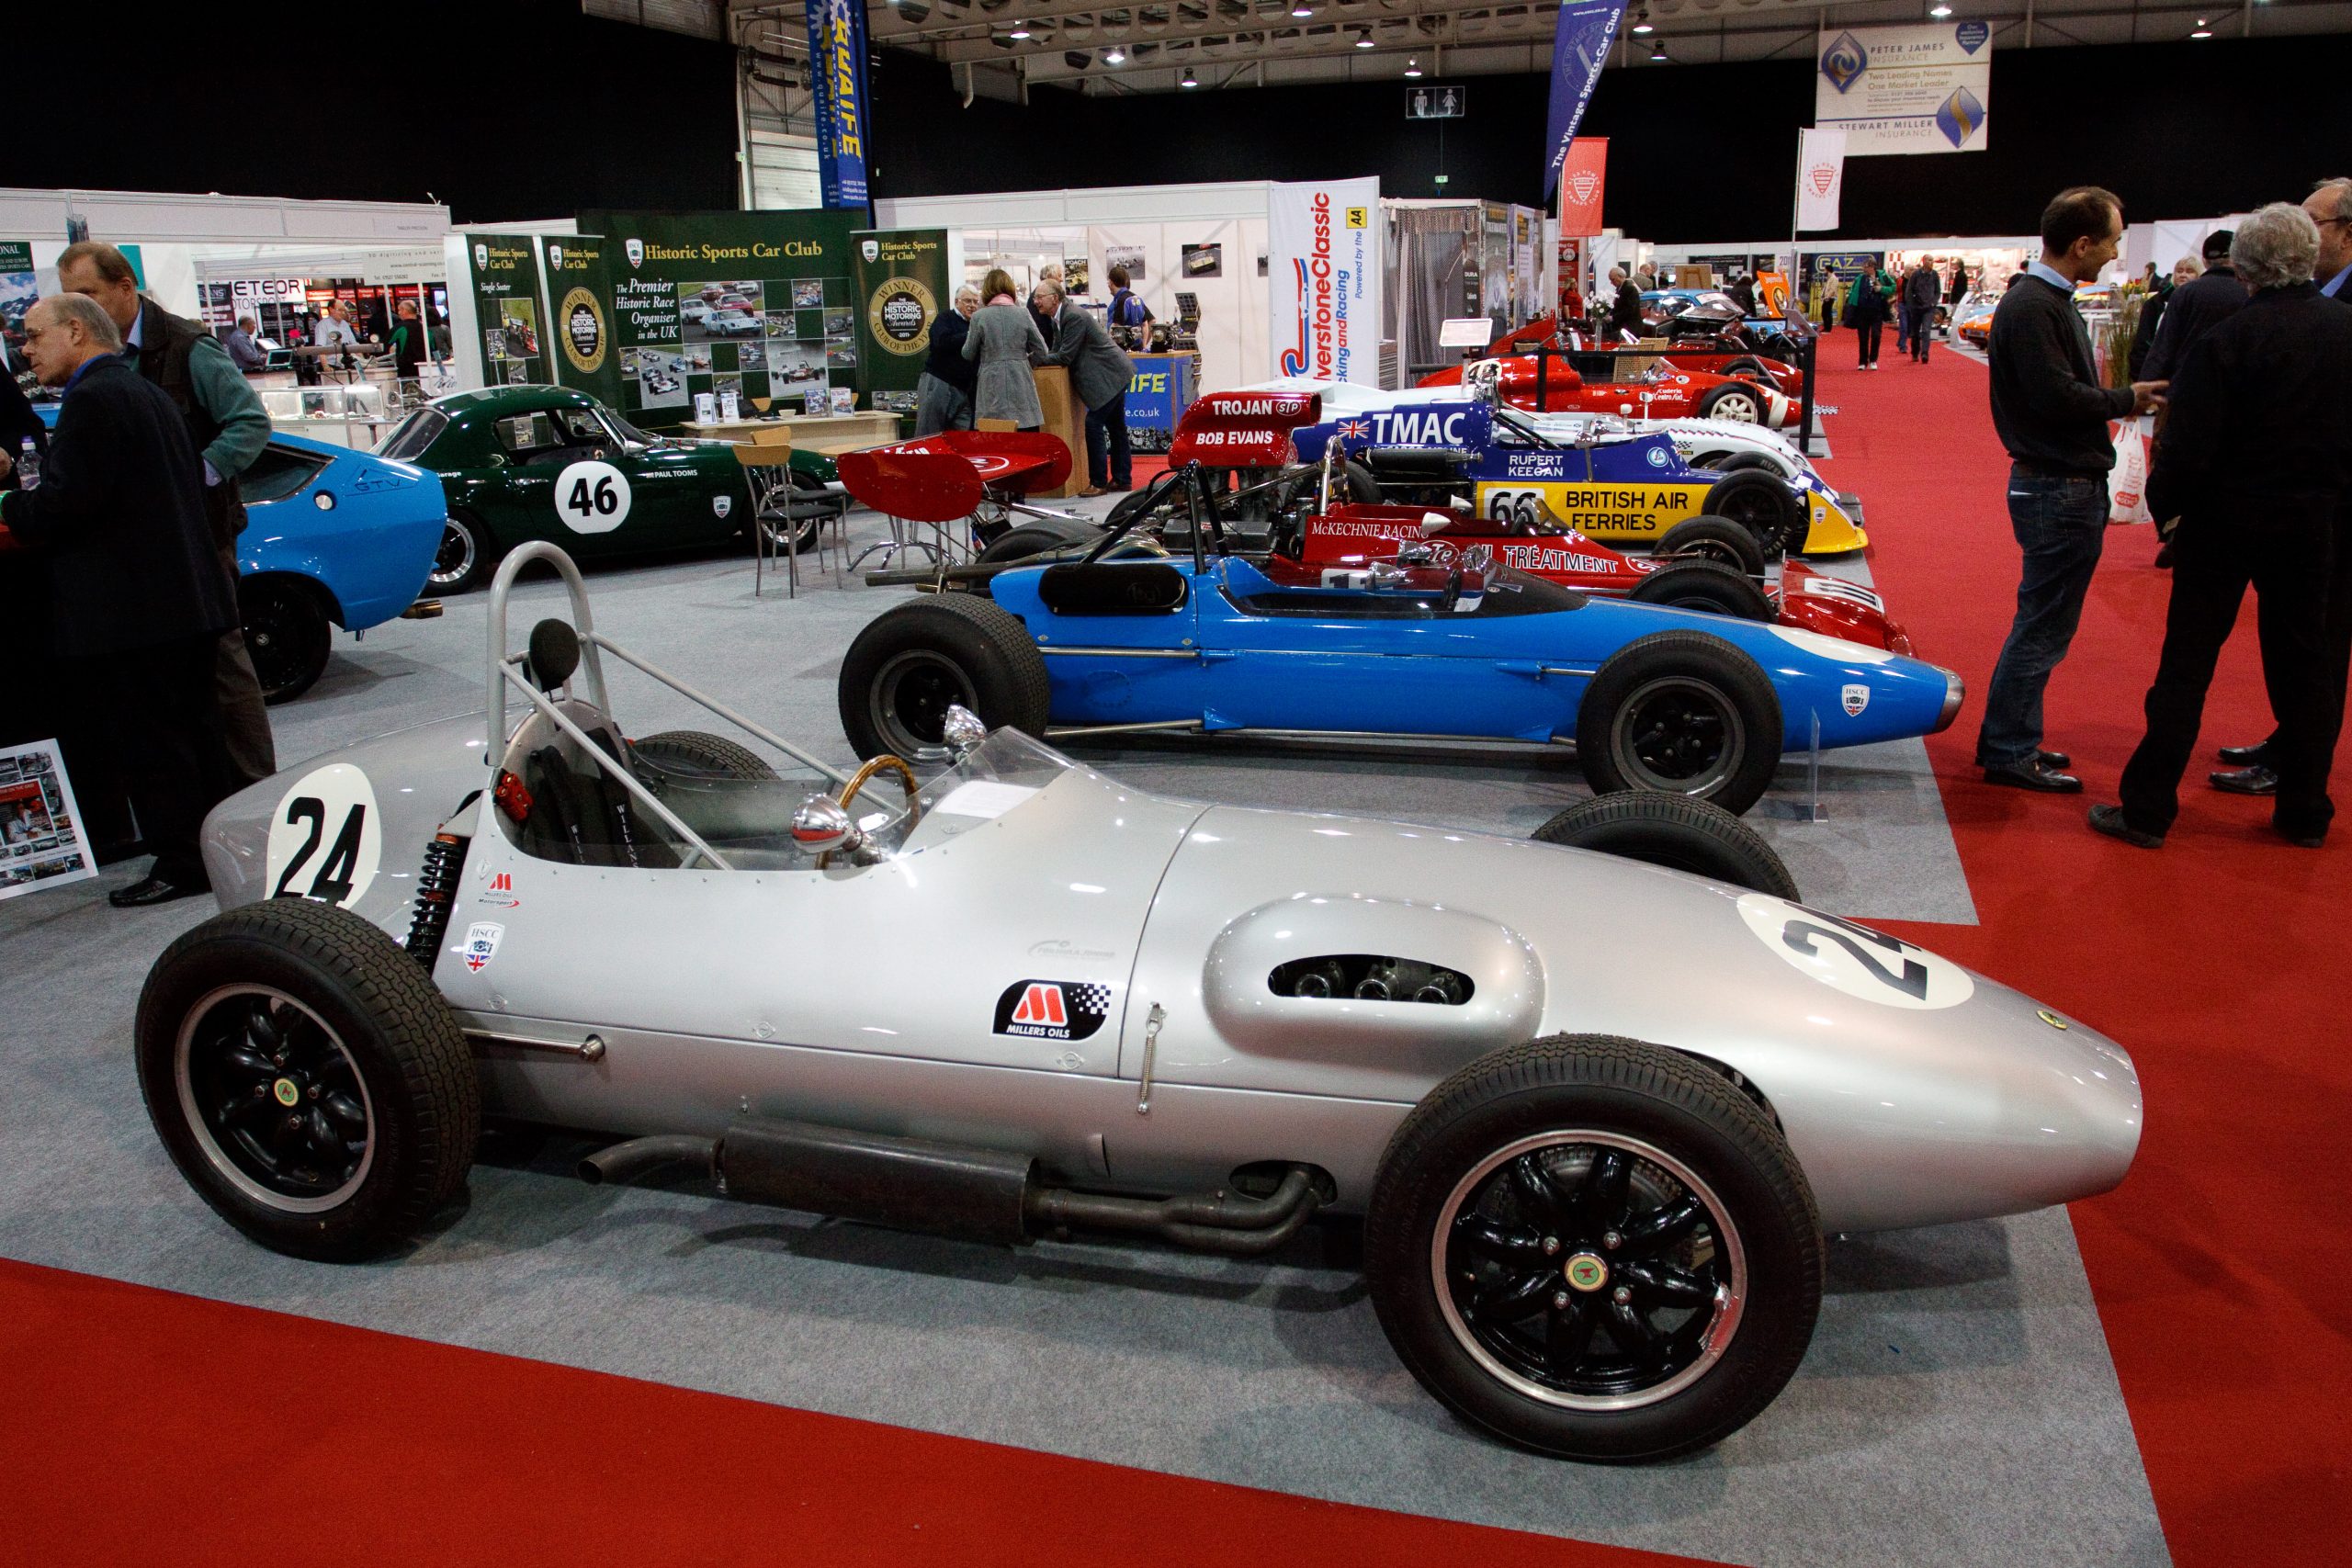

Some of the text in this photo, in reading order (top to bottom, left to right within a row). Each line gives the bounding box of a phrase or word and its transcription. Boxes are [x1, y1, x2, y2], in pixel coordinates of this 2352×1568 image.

[1871, 43, 1945, 54] PETER JAMES
[1870, 53, 1928, 63] INSURANCE
[1868, 69, 1953, 82] Two Leading Names
[835, 17, 862, 159] QUAIFE
[1552, 7, 1622, 168] The Vintage Sports-Car Club
[1888, 81, 1917, 89] Market
[1839, 120, 1933, 131] STEWART MILLER
[1874, 130, 1933, 139] INSURANCE
[1351, 209, 1363, 226] AA
[489, 248, 528, 260] Historic Sports
[645, 241, 822, 264] Historic Sports Car Club
[881, 241, 937, 253] Historic Sports
[563, 249, 599, 261] Historic Sports
[881, 252, 916, 261] Car Club
[490, 260, 514, 269] Car Club
[564, 260, 587, 269] Car Club
[1354, 231, 1364, 299] Powered by the
[1820, 258, 1855, 270] GAZ
[227, 280, 300, 296] ETEOR
[481, 282, 511, 294] Single Seater
[616, 278, 674, 294] The Premier
[878, 280, 925, 299] WINNER
[565, 292, 596, 310] WINNER
[616, 297, 675, 310] Historic Race
[884, 305, 922, 313] HISTORIC
[885, 312, 922, 321] MOTORING
[571, 318, 596, 327] HISTORIC
[631, 311, 676, 329] Organiser
[571, 326, 597, 334] MOTORING
[638, 325, 679, 340] in the UK
[874, 322, 889, 345] CLUB
[1125, 372, 1168, 393] IFE
[1213, 400, 1299, 415] TROJAN STP
[1372, 412, 1466, 445] TMAC
[1196, 430, 1273, 446] BOB EVANS
[1509, 455, 1564, 466] RUPERT
[1508, 467, 1564, 477] KEEGAN
[355, 479, 401, 491] GTV
[568, 475, 618, 516] 46
[1566, 491, 1689, 510] BRITISH AIR
[1489, 491, 1537, 523] 66
[1312, 522, 1380, 537] McKECHNIE
[1572, 513, 1657, 531] FERRIES
[1426, 543, 1453, 562] TP
[1503, 546, 1619, 574] TREATMENT
[272, 796, 367, 906] 24
[471, 927, 500, 939] HSCC
[1782, 900, 1928, 1001] 24
[1006, 1023, 1070, 1039] MILLERS OILS
